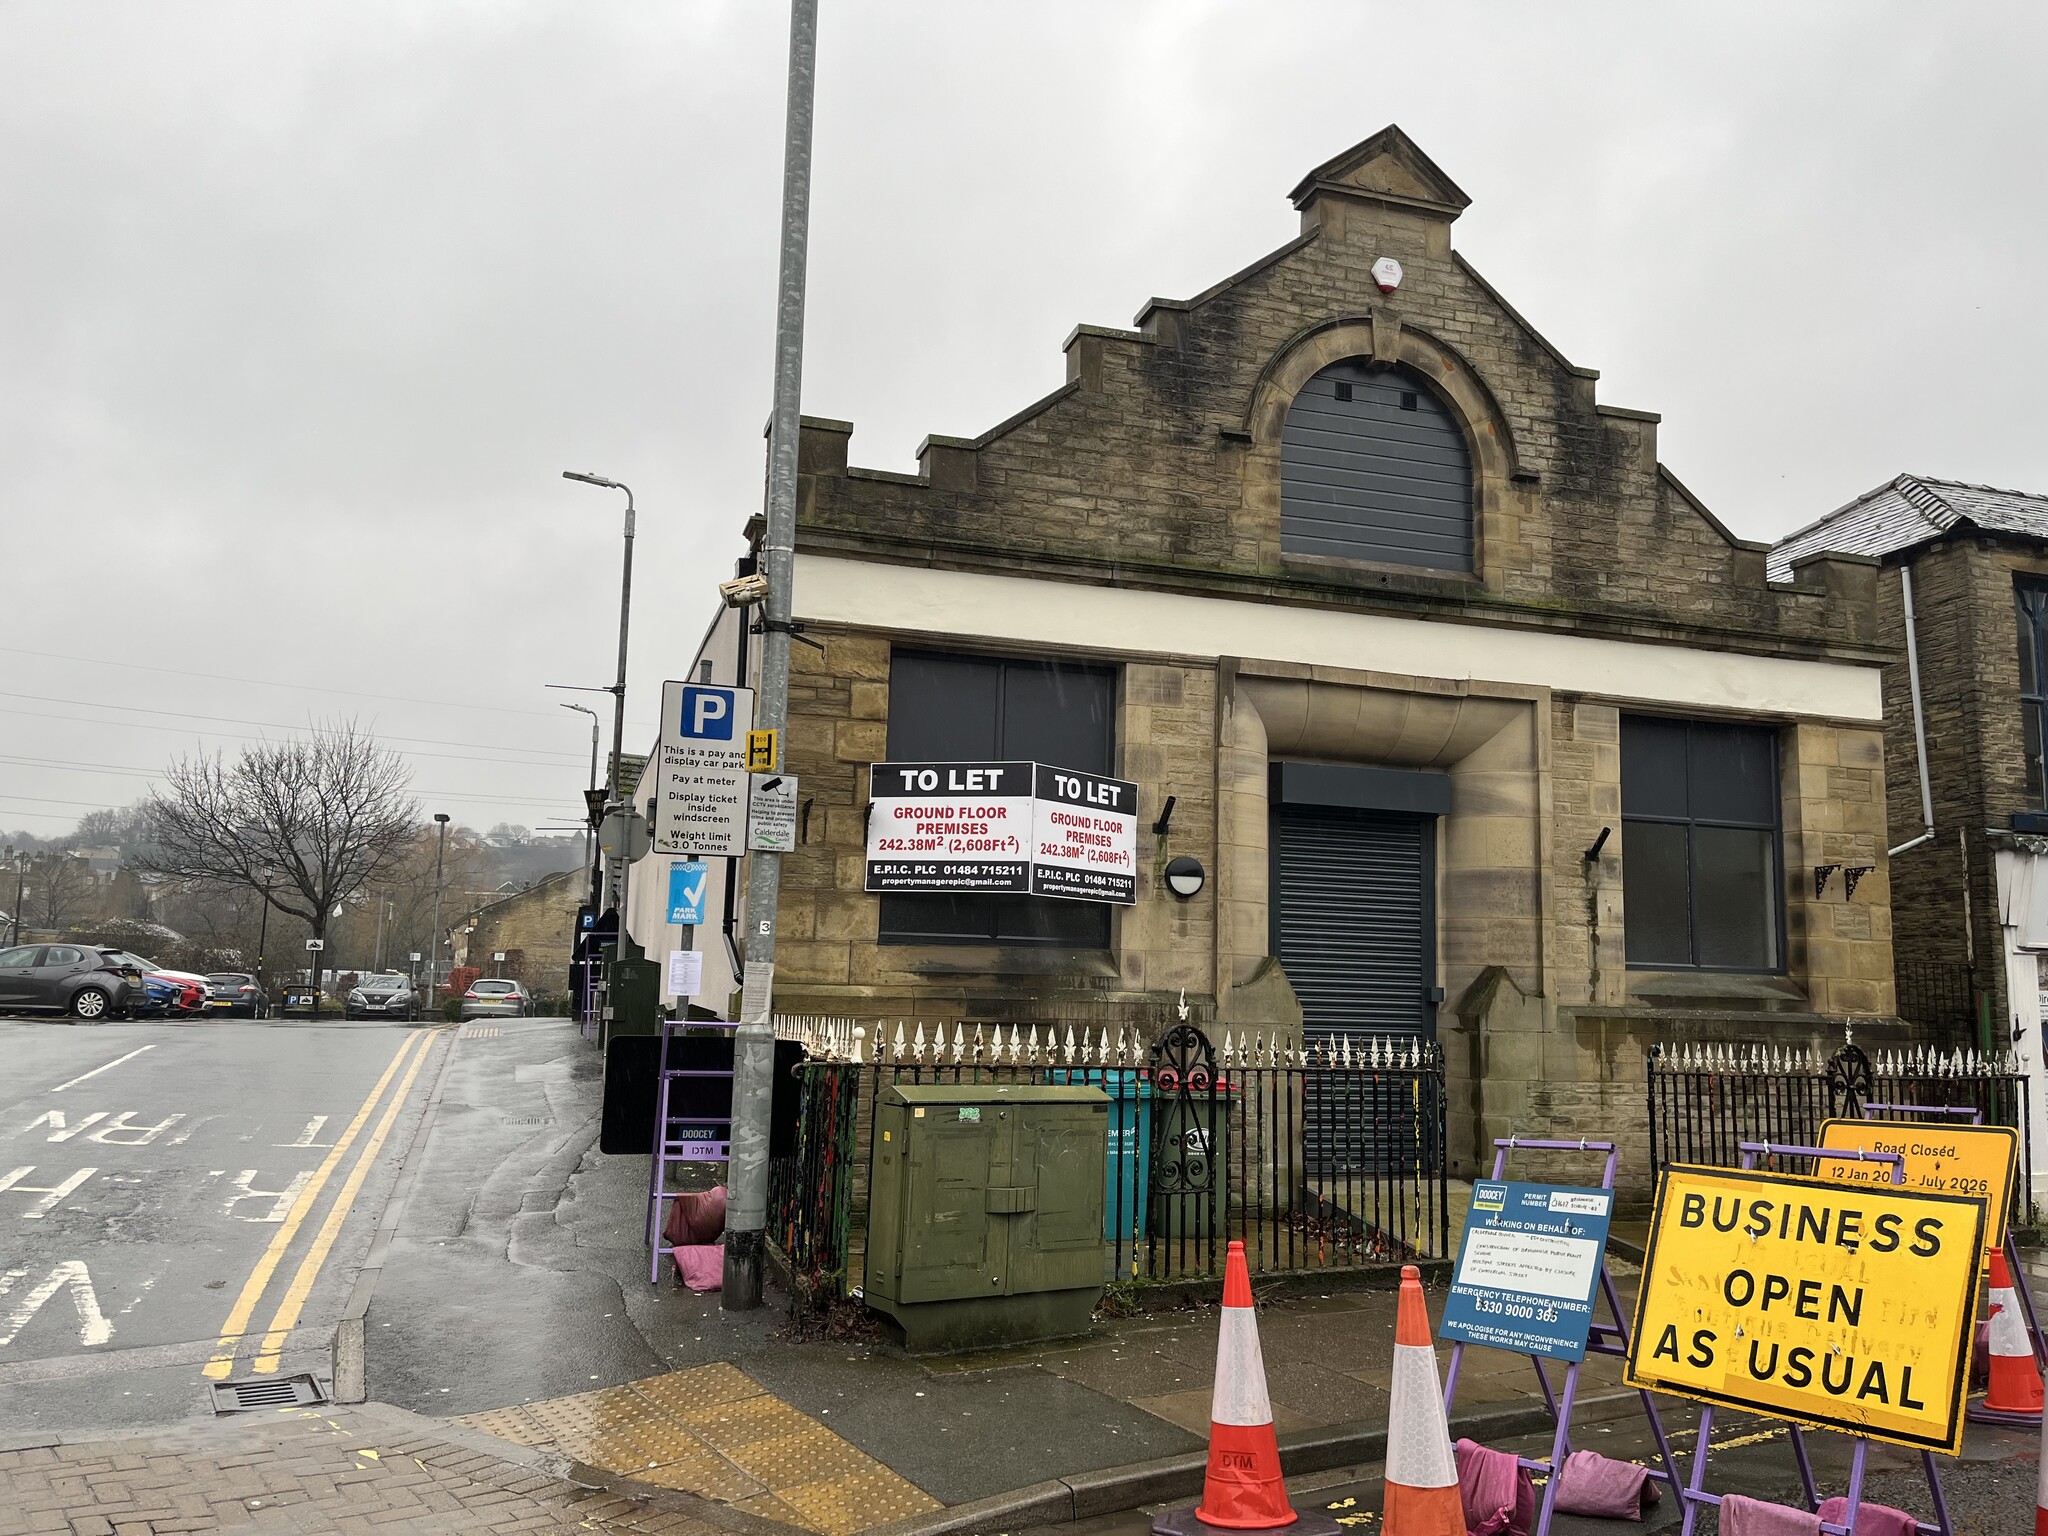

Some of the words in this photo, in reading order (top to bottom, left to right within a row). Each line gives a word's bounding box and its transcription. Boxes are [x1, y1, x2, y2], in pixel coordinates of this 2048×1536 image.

[694, 694, 726, 734] P
[664, 746, 684, 754] This
[708, 750, 725, 759] pay
[749, 734, 772, 766] H
[664, 756, 700, 767] display
[672, 774, 690, 784] Pay
[694, 776, 704, 784] at
[707, 778, 736, 786] meter
[900, 769, 938, 791] TO
[948, 769, 1004, 790] LET
[669, 792, 705, 802] Display
[709, 794, 737, 803] ticket
[1054, 774, 1080, 799] TO
[1087, 781, 1121, 806] LET
[688, 804, 716, 812] inside
[894, 807, 954, 819] GROUND
[959, 807, 1007, 819] FLOOR
[674, 813, 730, 823] windscreen
[1050, 812, 1090, 829] GROUND
[1094, 819, 1122, 834] FLOOR
[670, 830, 705, 840] Weight
[709, 832, 731, 841] limit
[754, 828, 790, 838] Calderdale
[916, 823, 988, 835] PREMISES
[672, 841, 689, 849] 3.0
[694, 842, 728, 850] Tonnes
[879, 836, 944, 851] 242.38M²
[949, 836, 1020, 854] (2,608Ft²)
[1066, 830, 1112, 848] PREMISES
[874, 865, 911, 875] E.P.I.C.
[914, 866, 936, 874] PLC
[944, 866, 978, 875] 01484
[982, 866, 1022, 876] 715211
[1038, 868, 1064, 880] E.P.I.C.
[1066, 872, 1080, 882] PLC
[1084, 875, 1106, 886] 01484
[1108, 878, 1132, 888] 715211
[882, 878, 1012, 886] propertymanagerepic@gmail.com
[584, 916, 592, 926] P
[762, 923, 770, 931] 3
[290, 996, 297, 1004] P
[682, 1130, 714, 1138] DOOCEY
[1874, 1142, 1906, 1154] Road
[1911, 1144, 1956, 1158] Closed
[1832, 1167, 1843, 1178] 12
[1848, 1168, 1868, 1180] Jan
[1873, 1170, 1907, 1184] 206
[1919, 1175, 1946, 1190] July
[1950, 1178, 1988, 1192] 2026
[1479, 1190, 1504, 1200] DOOCEY
[1486, 1218, 1522, 1230] WORKING
[1524, 1222, 1535, 1230] ON
[1572, 1228, 1586, 1236] OF:
[1680, 1193, 1944, 1258] BUSINESS
[1452, 1286, 1500, 1299] EMERGENCY
[1502, 1293, 1549, 1306] TELEPHONE
[1551, 1300, 1590, 1314] NUMBER:
[1724, 1270, 1864, 1327] OPEN
[1476, 1300, 1502, 1314] 0330
[1505, 1304, 1533, 1319] 9000
[1536, 1308, 1558, 1323] 365
[1448, 1320, 1456, 1328] WE
[1458, 1322, 1494, 1334] APOLOGISE
[1495, 1328, 1508, 1336] FOR
[1509, 1330, 1523, 1339] ANY
[1524, 1332, 1579, 1349] INCONVENIENCE
[1468, 1331, 1488, 1341] THESE
[1489, 1335, 1513, 1345] WORKS
[1514, 1339, 1528, 1348] MAY
[1529, 1342, 1552, 1352] CAUSE
[1652, 1324, 1718, 1369] AS
[1748, 1340, 1924, 1410] USUAL
[1223, 1454, 1252, 1469] DTM
